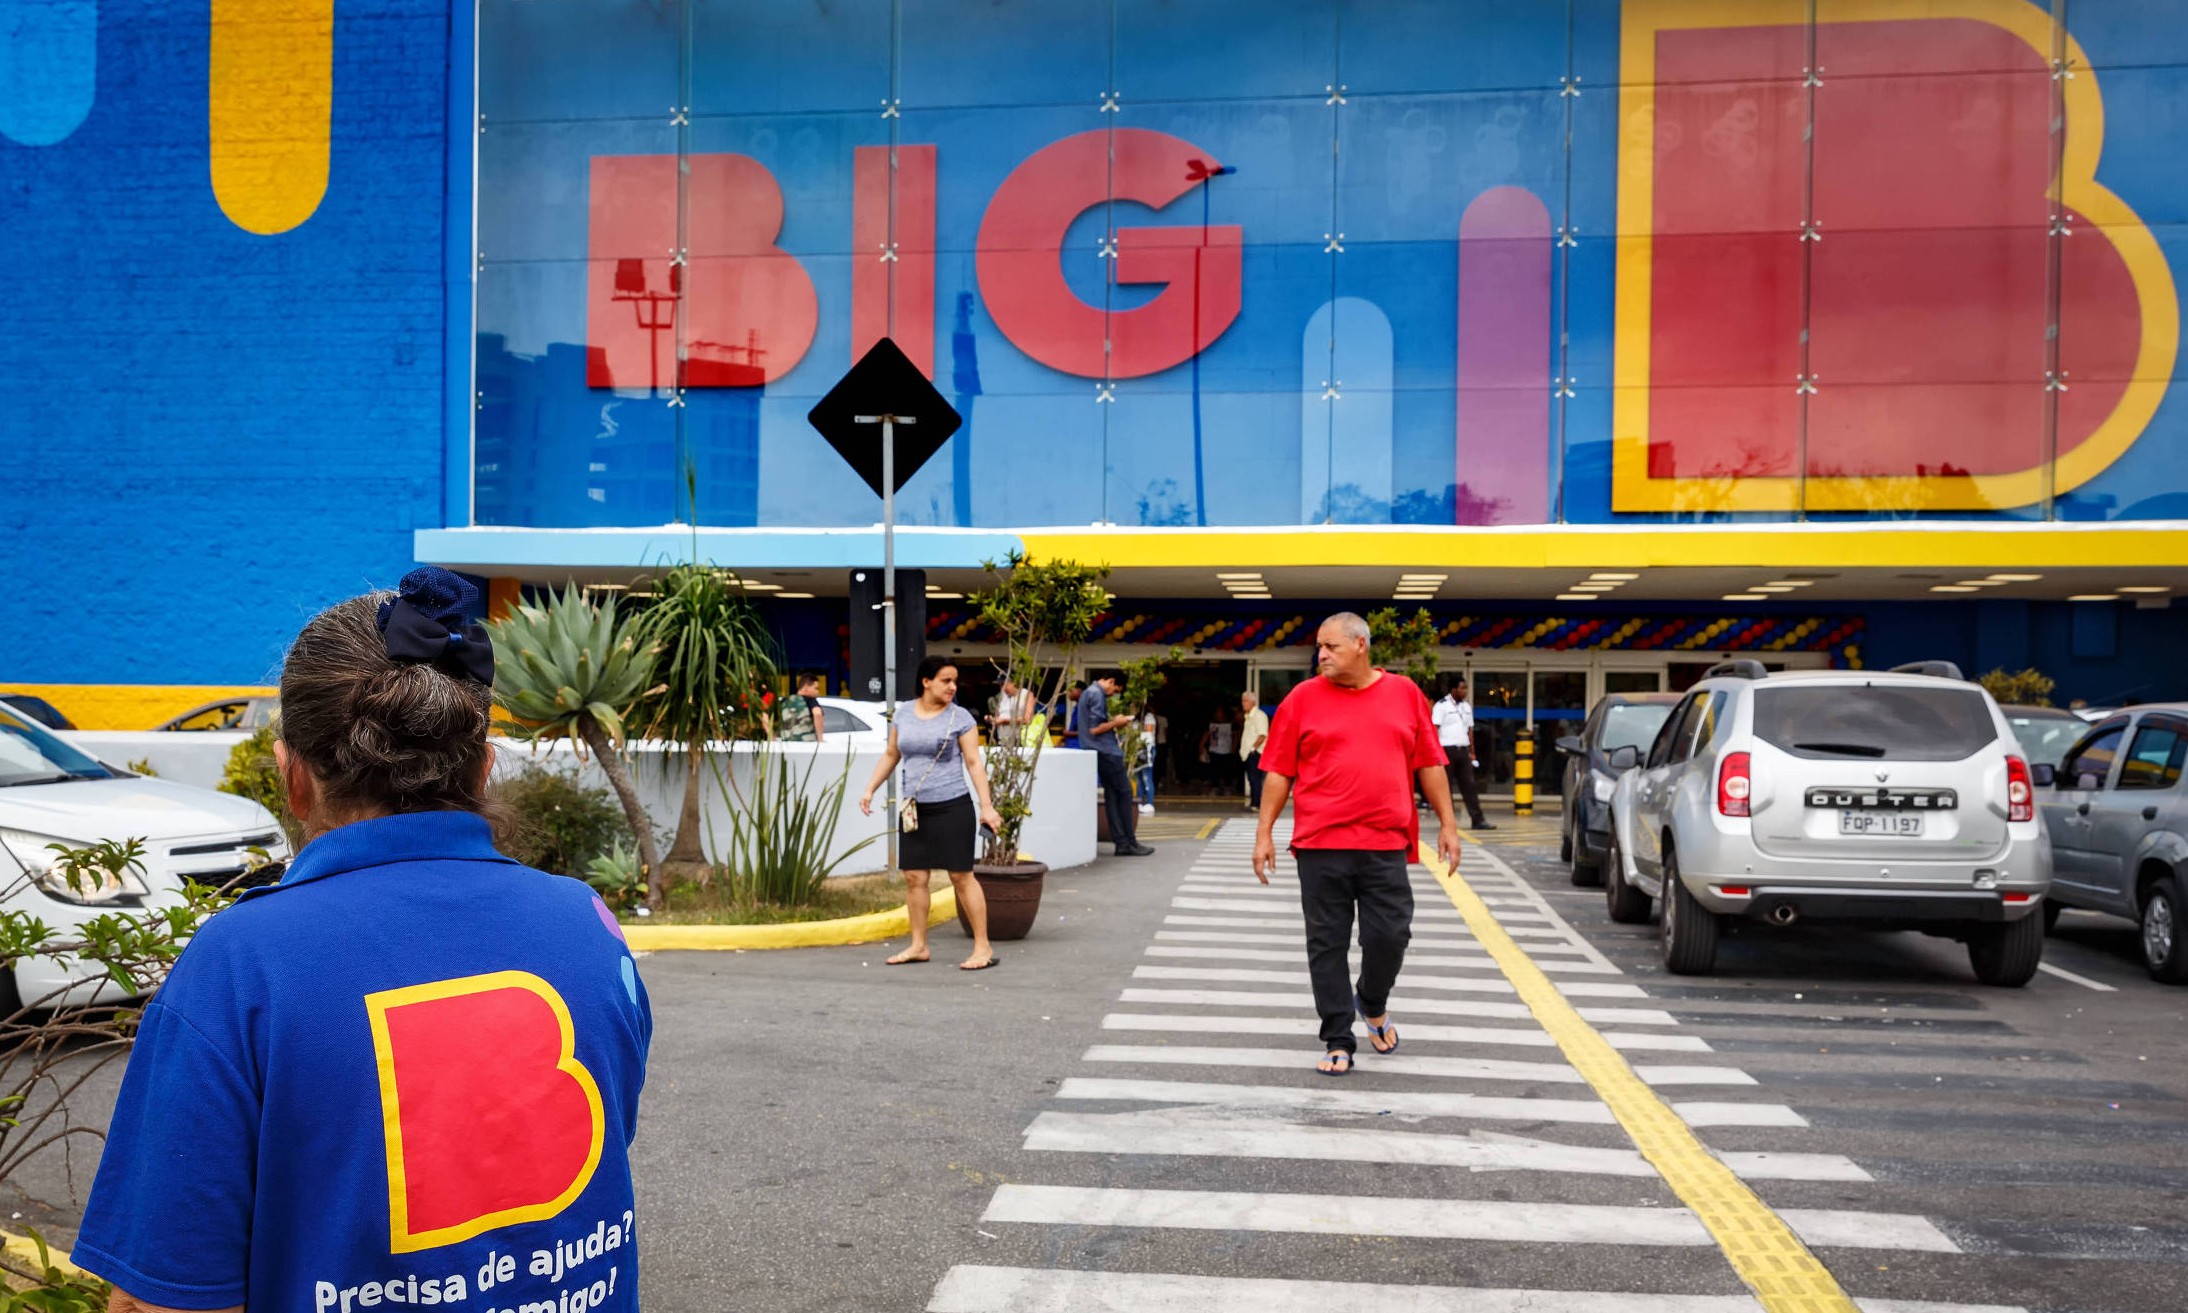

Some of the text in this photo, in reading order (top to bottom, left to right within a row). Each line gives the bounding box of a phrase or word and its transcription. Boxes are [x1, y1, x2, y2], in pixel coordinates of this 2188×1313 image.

[586, 128, 1242, 388] BIG
[1612, 0, 2179, 512] B
[1811, 794, 1953, 807] DUSTER
[364, 970, 605, 1255] B
[315, 1209, 634, 1313] Precisa de ajuda?
[484, 1266, 618, 1313] migo!
